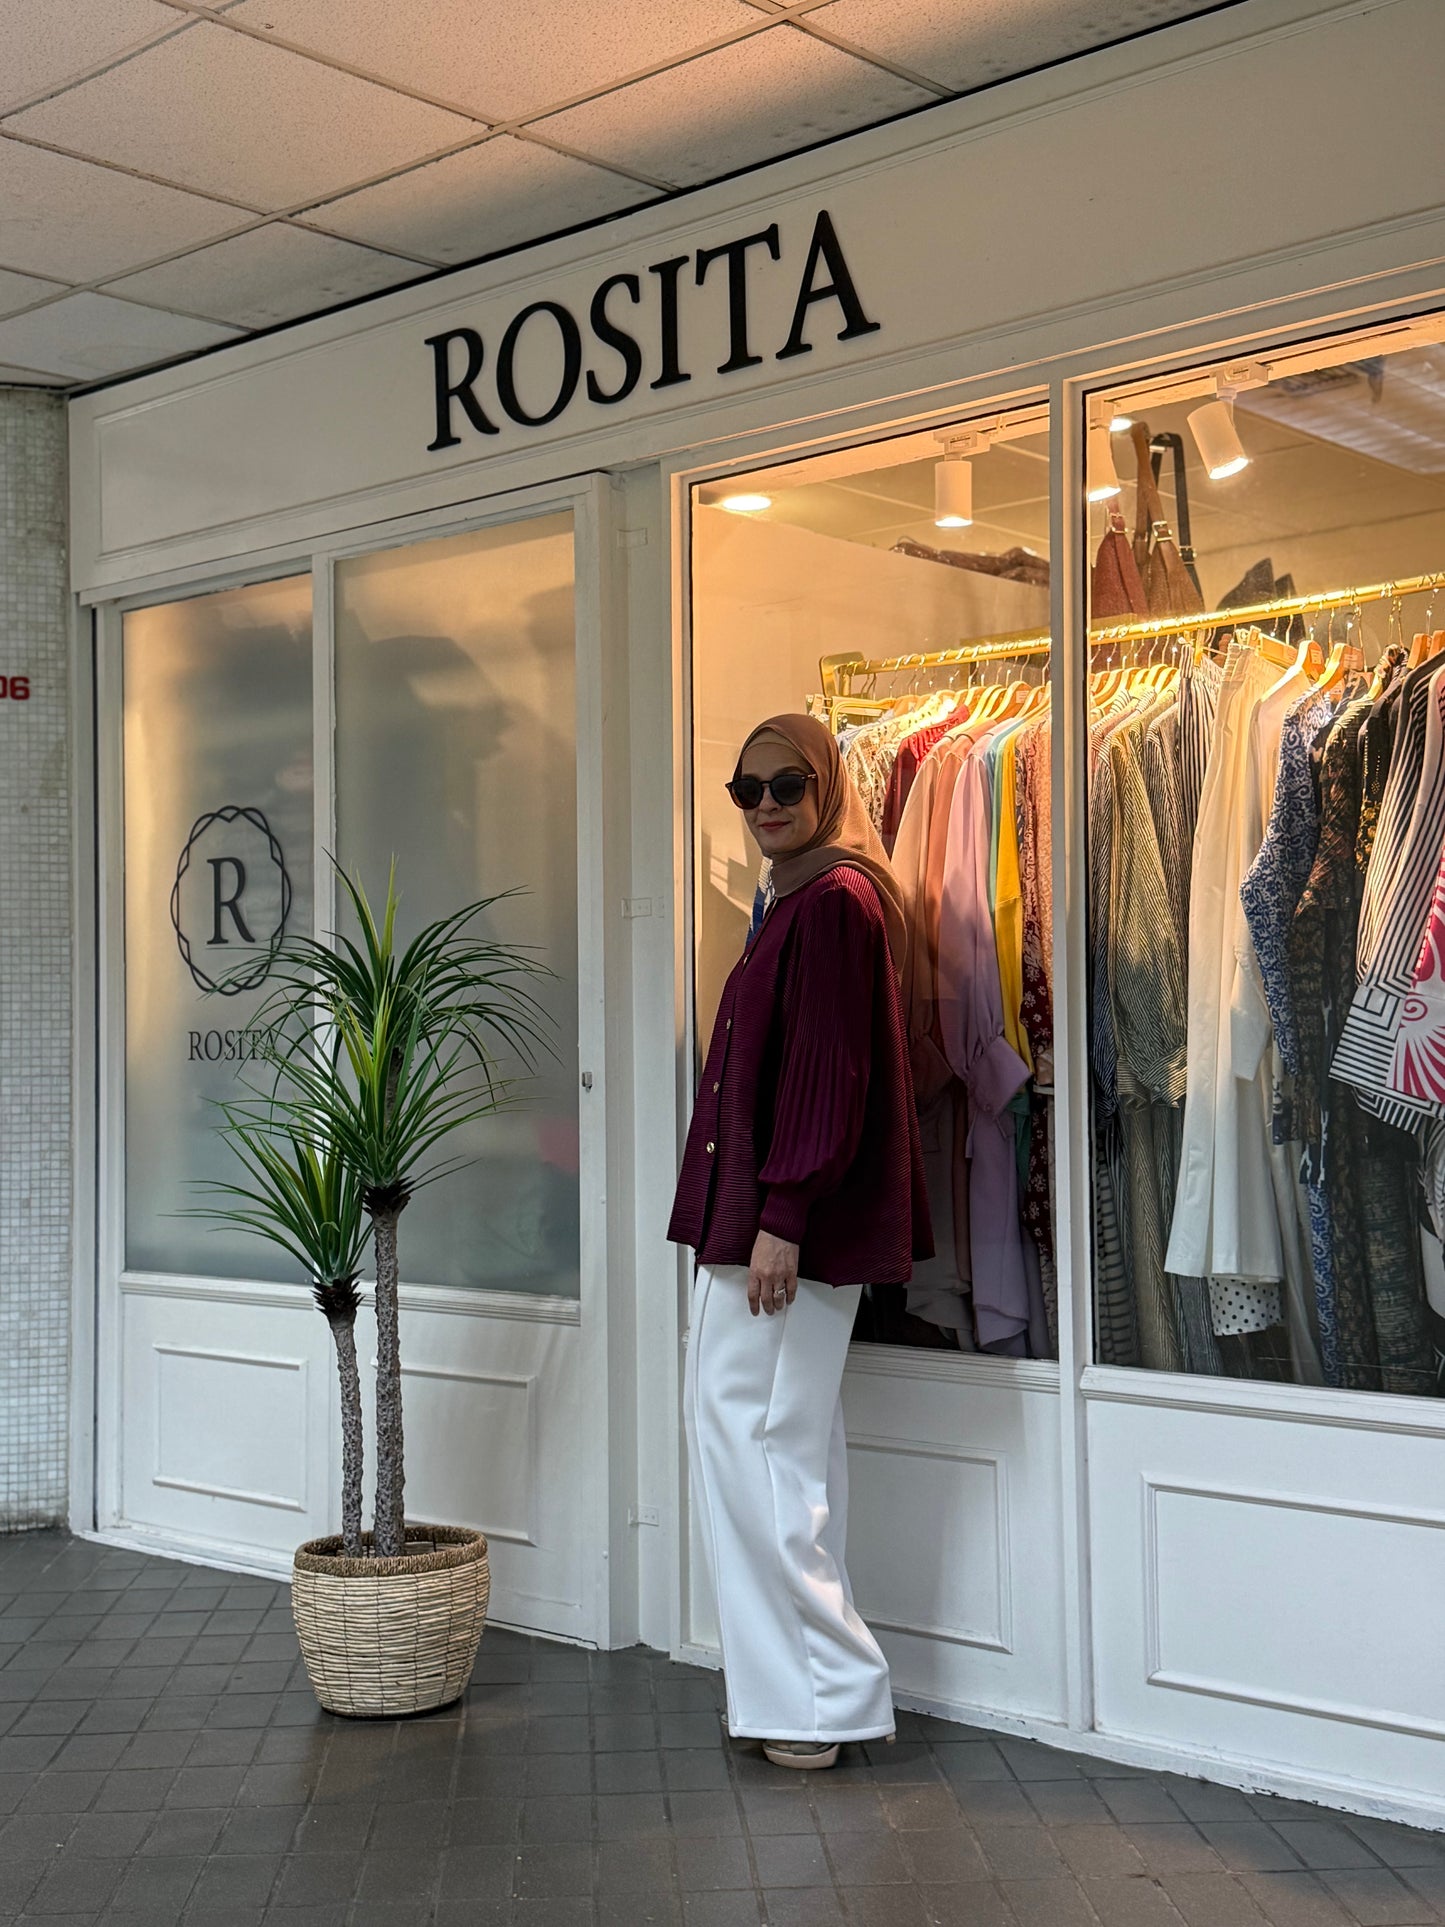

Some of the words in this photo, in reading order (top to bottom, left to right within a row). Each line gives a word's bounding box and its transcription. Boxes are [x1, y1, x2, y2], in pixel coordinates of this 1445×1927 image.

[425, 209, 881, 452] ROSITA
[206, 856, 256, 945] R
[188, 1029, 278, 1062] ROSITA
